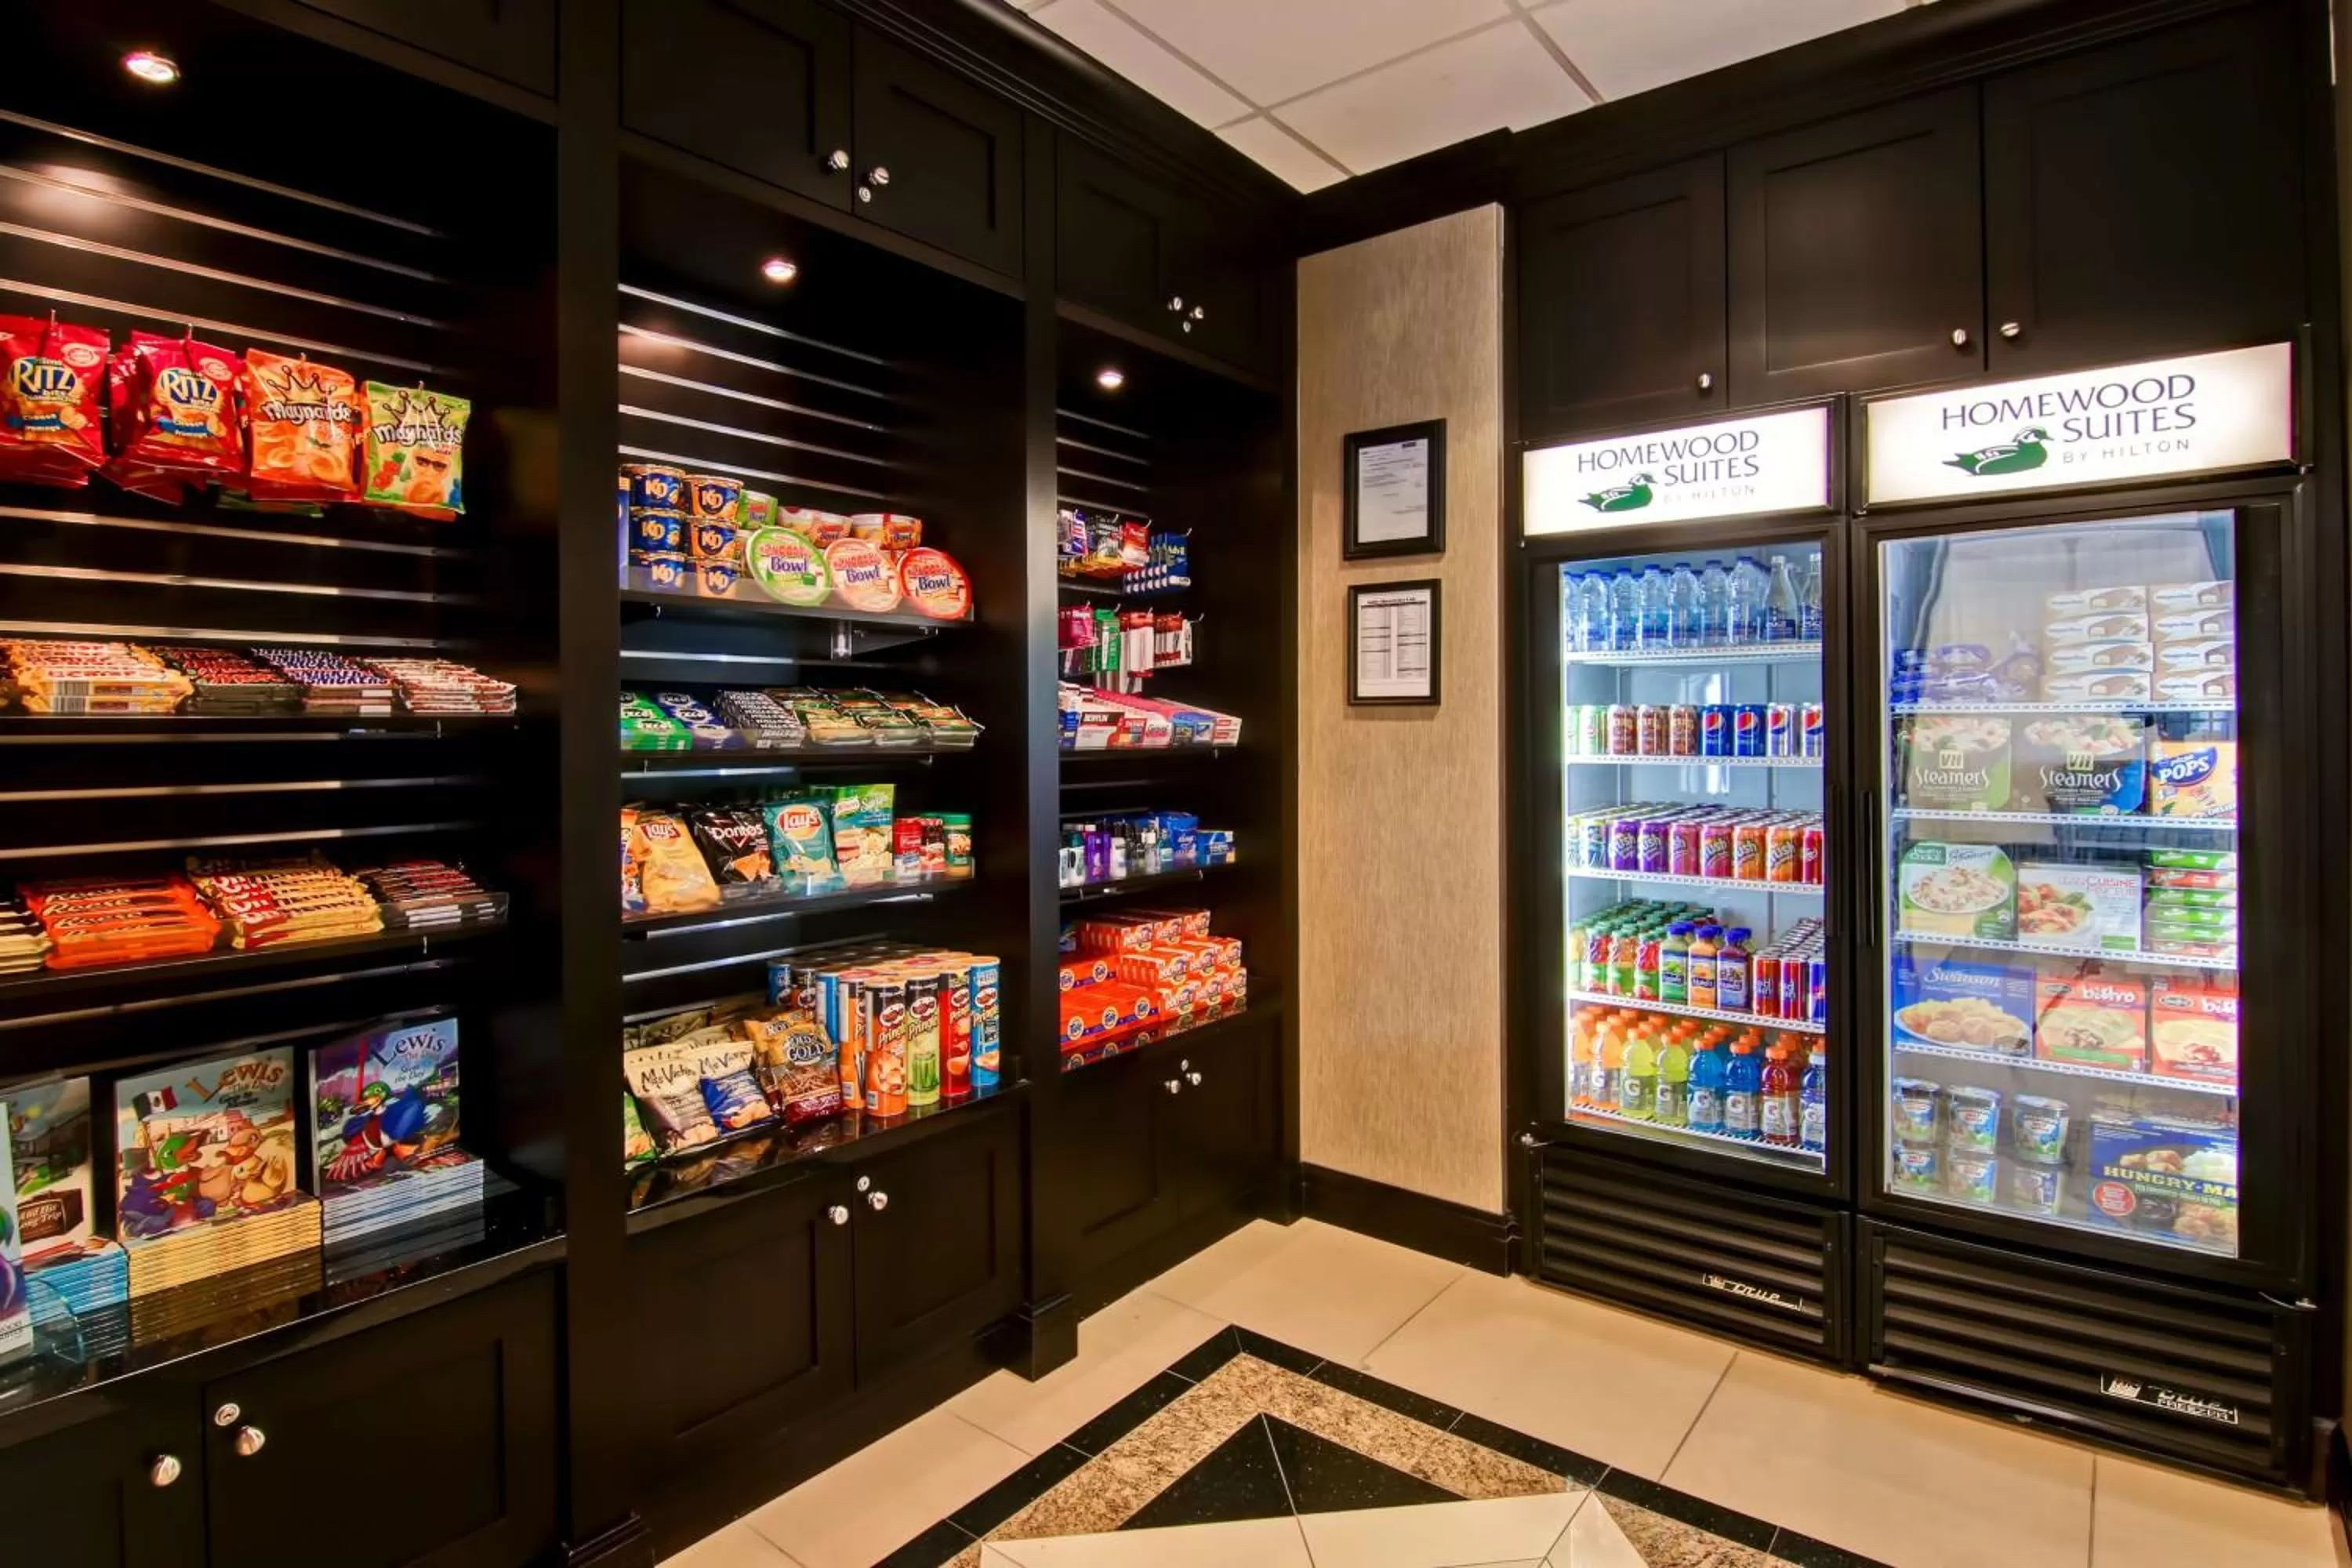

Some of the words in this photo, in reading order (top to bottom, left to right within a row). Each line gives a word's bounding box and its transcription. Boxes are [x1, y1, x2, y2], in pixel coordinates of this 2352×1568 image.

[14, 358, 73, 393] RITZ
[161, 369, 217, 403] RITZ
[261, 401, 352, 425] Maynards
[1942, 374, 2196, 430] HOMEWOOD
[372, 423, 463, 446] Maynards
[2062, 402, 2197, 443] SUITES
[1578, 430, 1760, 473] HOMEWOOD
[2063, 452, 2088, 464] BY
[2102, 438, 2190, 459] HILTON
[1664, 454, 1760, 487] SUITES
[1690, 484, 1755, 501] HILTON
[771, 557, 808, 573] Bowl
[846, 566, 880, 583] Bowl
[917, 576, 952, 590] Bowl
[2158, 755, 2211, 782] POPS
[710, 823, 764, 840] Doritos
[1924, 967, 2000, 988] Swanson
[371, 1028, 446, 1068] Lewis
[185, 1054, 284, 1104] Lewis
[1624, 1079, 1641, 1096] G
[1657, 1084, 1672, 1101] G
